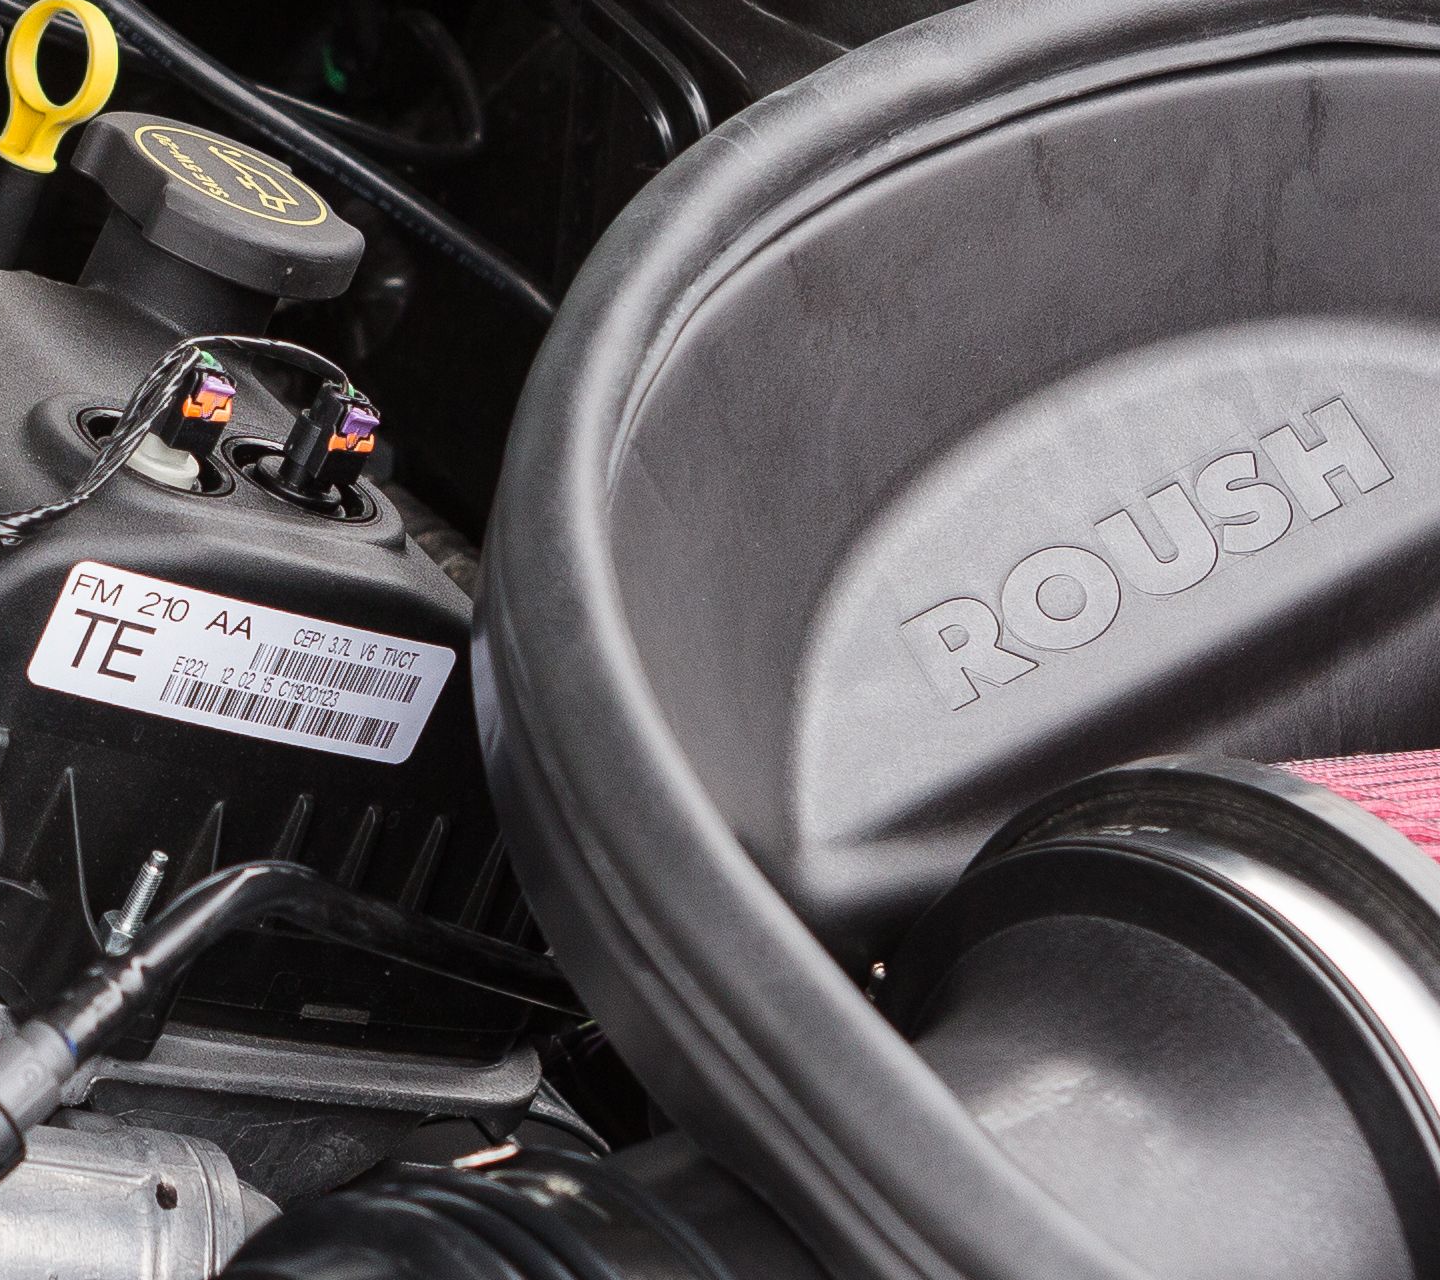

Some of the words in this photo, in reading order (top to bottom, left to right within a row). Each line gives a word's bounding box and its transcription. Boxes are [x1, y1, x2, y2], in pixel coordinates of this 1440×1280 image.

[901, 396, 1395, 711] ROUSH
[71, 573, 124, 607] FM
[137, 591, 190, 622] 210
[205, 610, 252, 641] AA
[70, 607, 158, 683] TE
[172, 655, 209, 679] E1221
[220, 667, 235, 685] 12
[237, 671, 256, 690] 02
[260, 676, 275, 694] 15
[328, 636, 353, 657] 3.7L
[359, 641, 378, 662] V6
